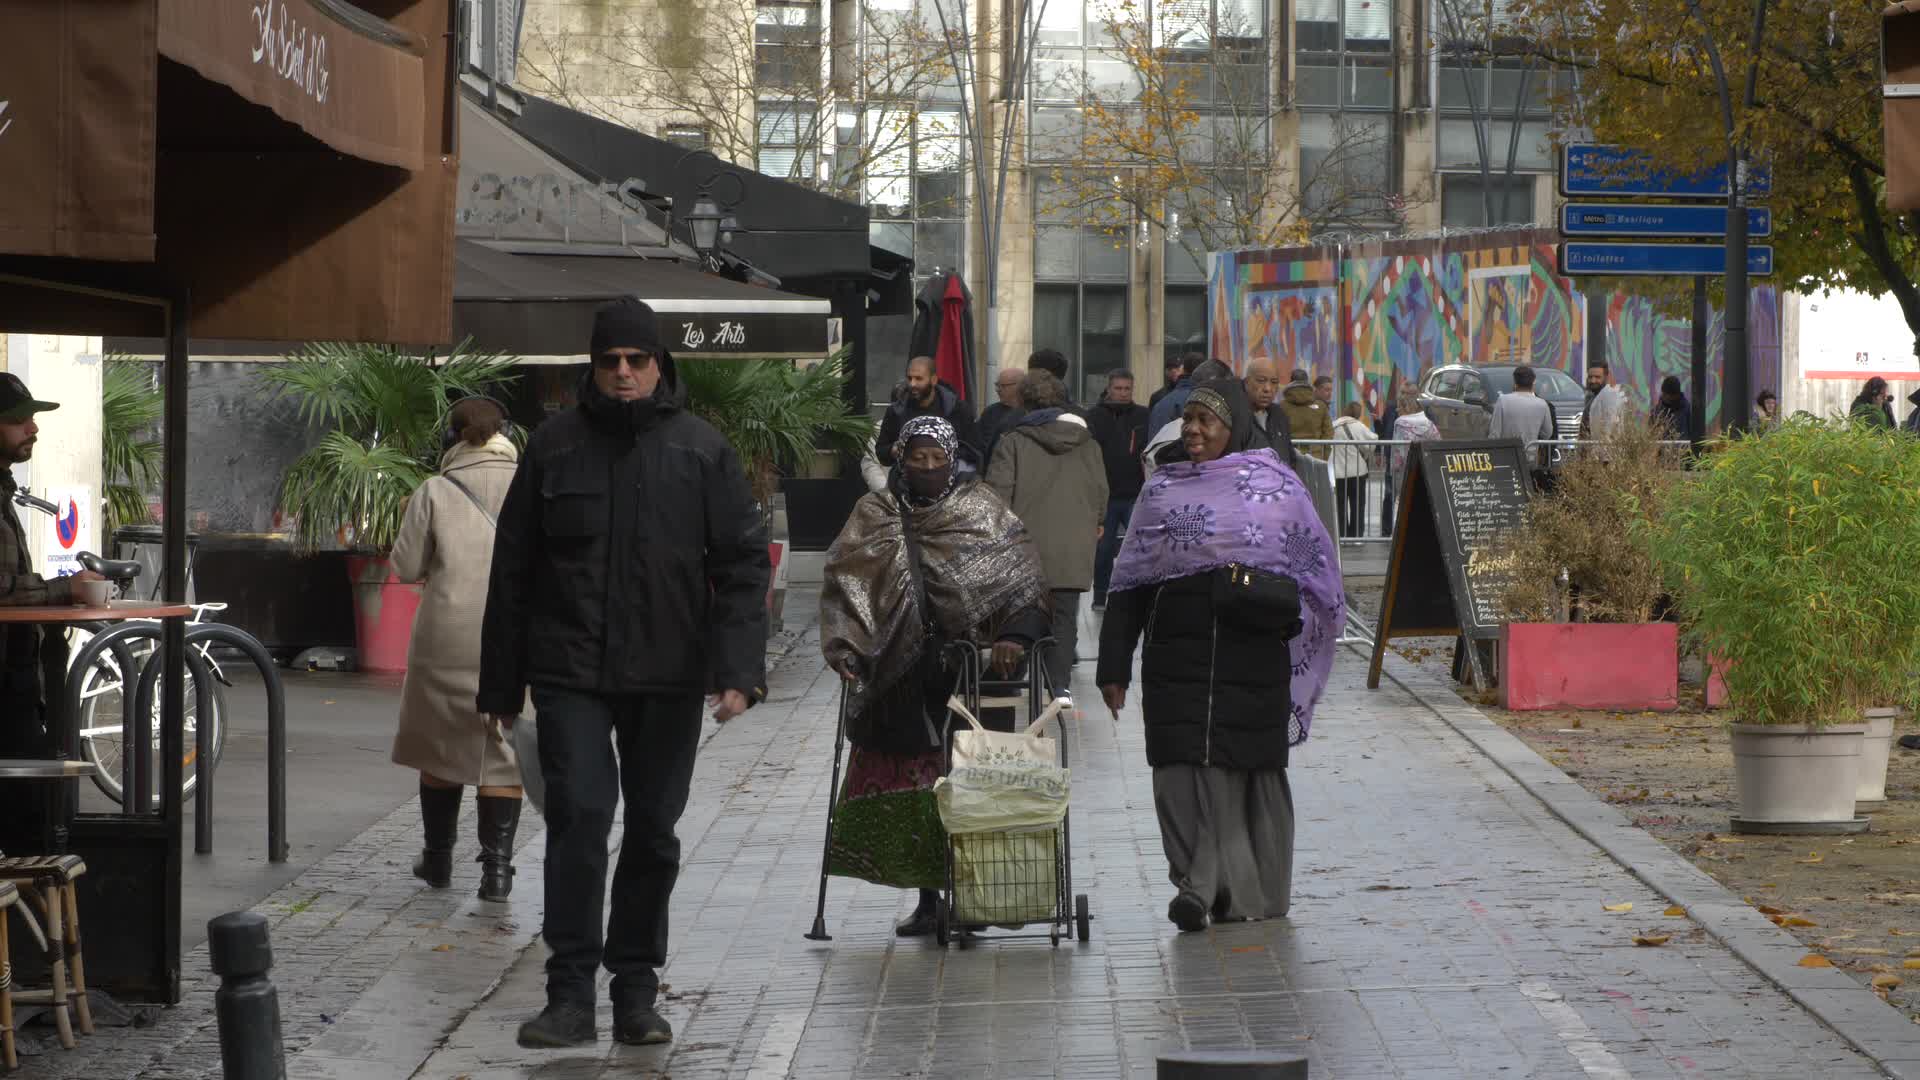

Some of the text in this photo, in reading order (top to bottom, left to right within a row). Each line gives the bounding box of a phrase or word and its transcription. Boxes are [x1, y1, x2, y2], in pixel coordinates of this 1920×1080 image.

[681, 321, 746, 348] Les Arts
[1445, 452, 1493, 472] ENTRÉES
